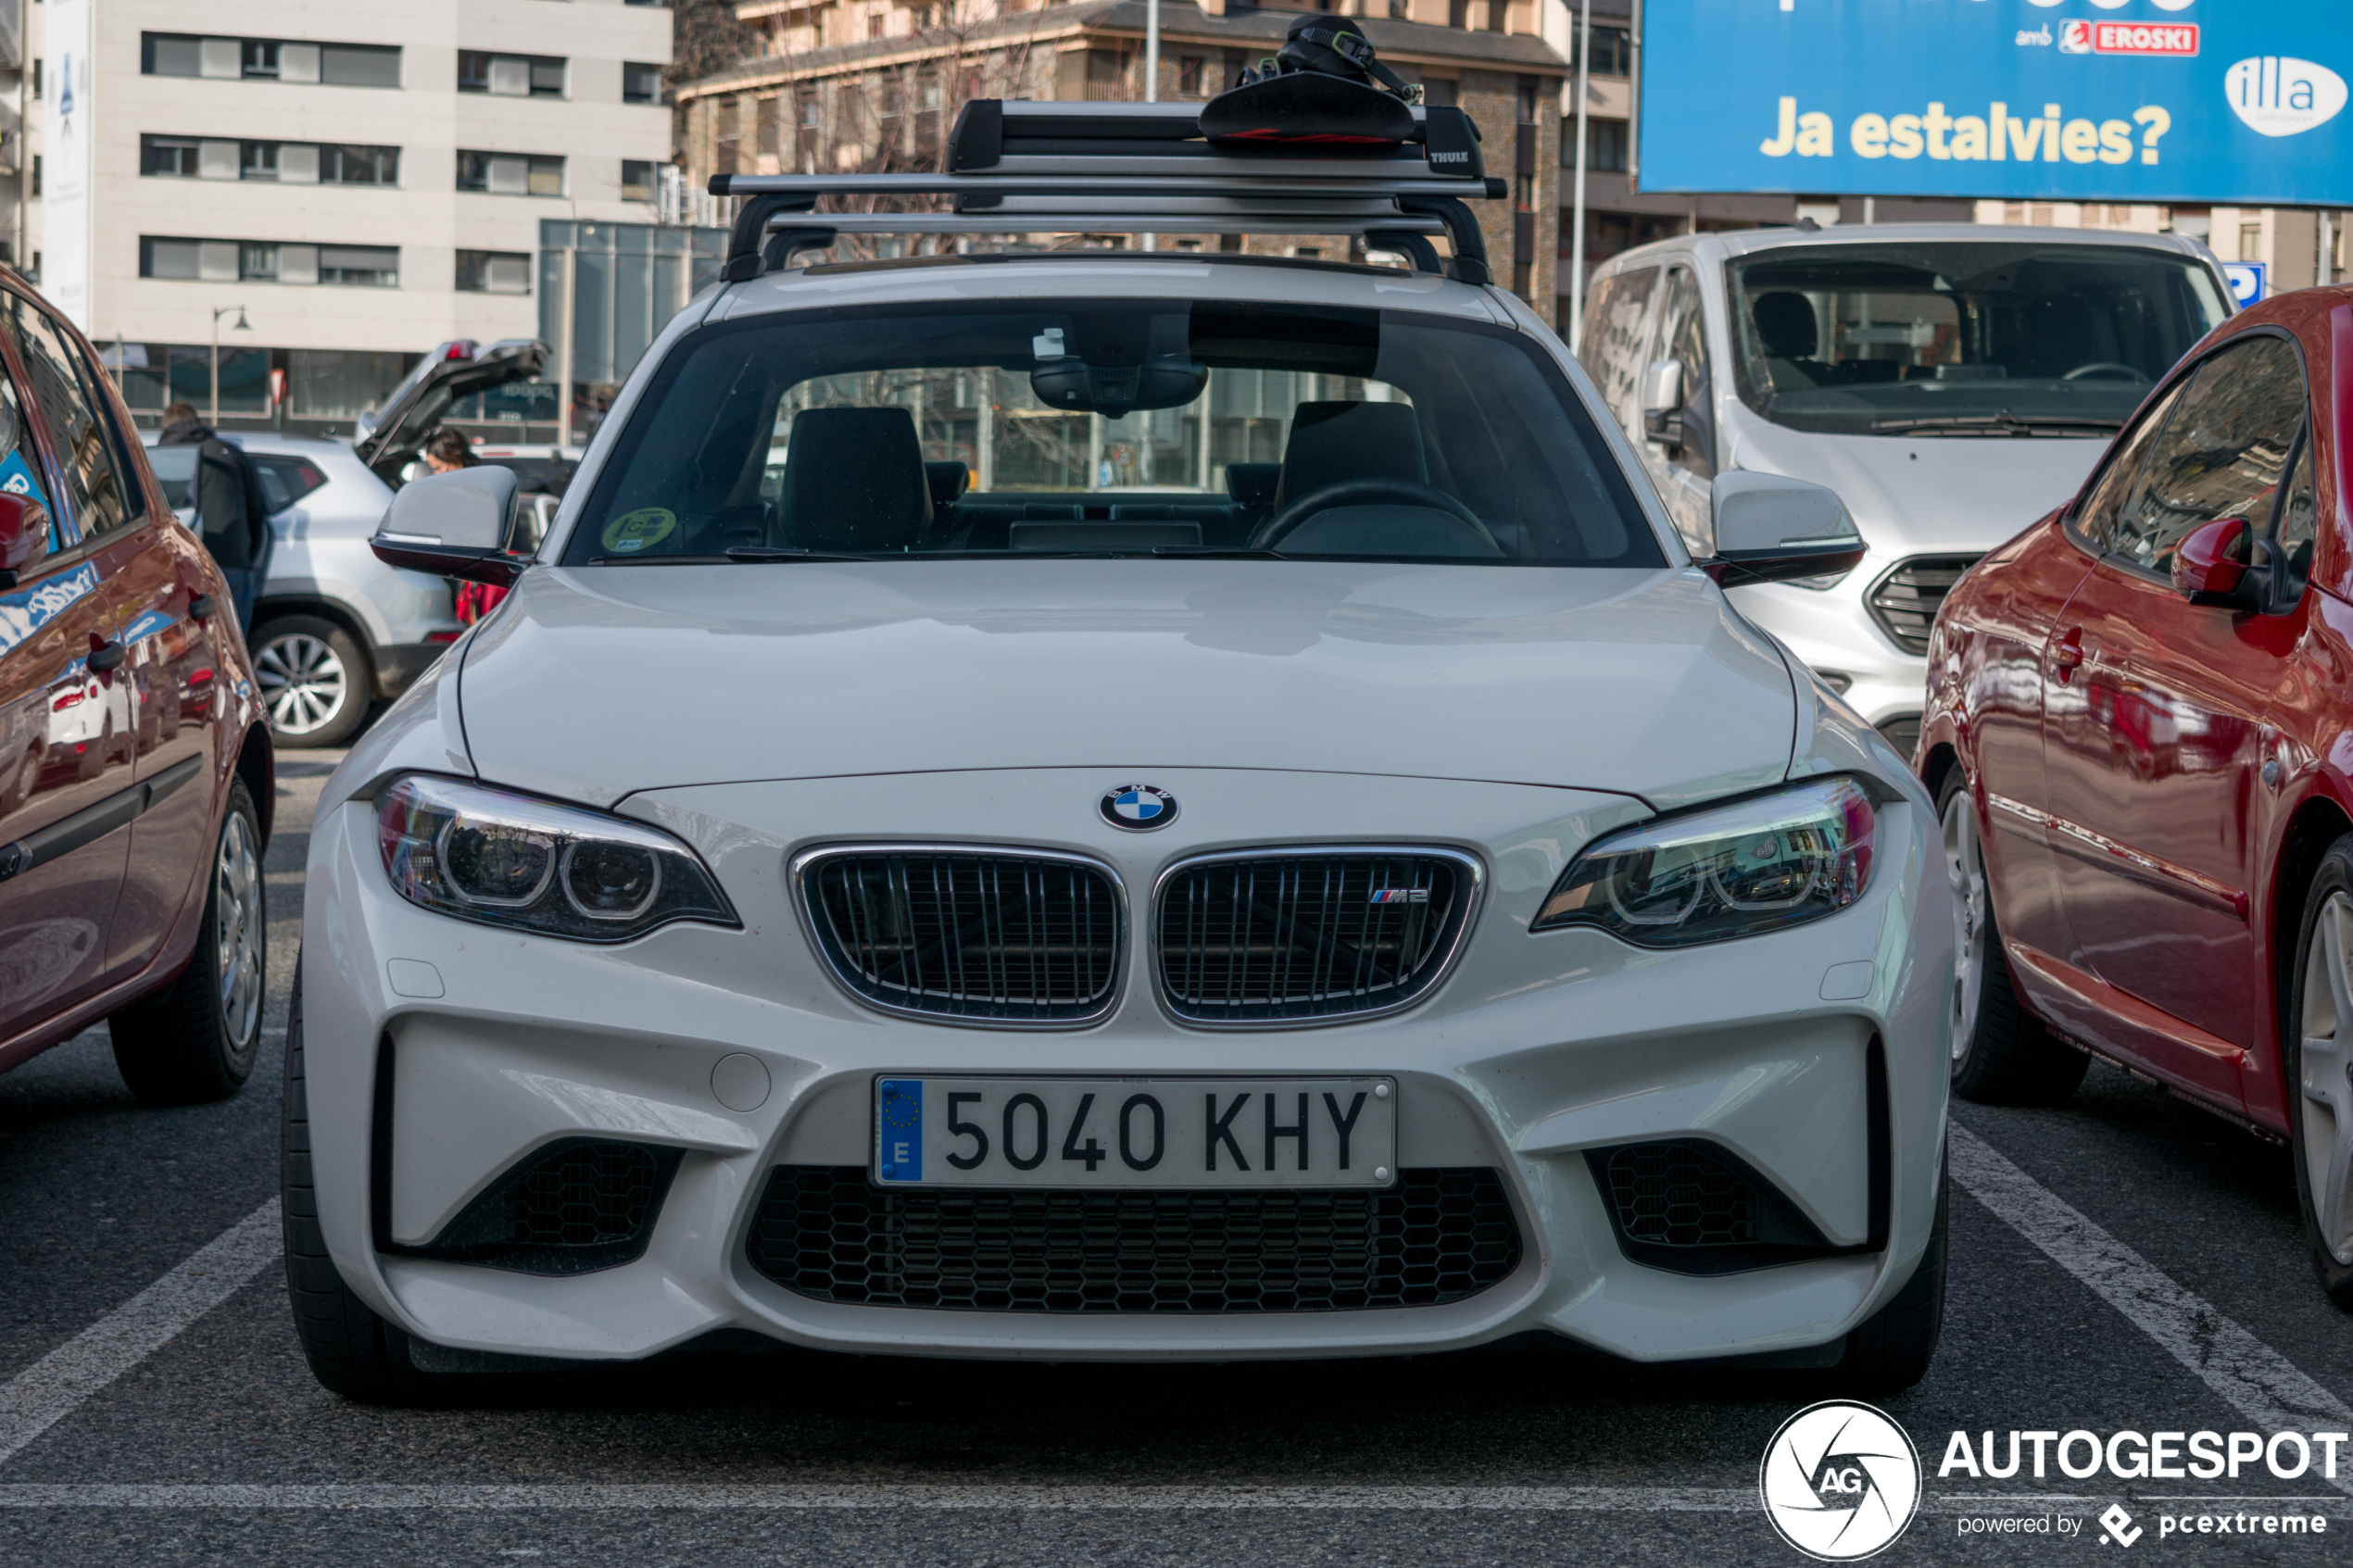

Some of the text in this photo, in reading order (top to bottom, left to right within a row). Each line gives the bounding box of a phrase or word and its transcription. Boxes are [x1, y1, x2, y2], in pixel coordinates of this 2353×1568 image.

[2015, 22, 2053, 46] amb
[2099, 26, 2192, 50] EROSKI
[2241, 56, 2314, 110] illa
[1759, 96, 2171, 166] Ja estalvies?
[1429, 151, 1469, 164] THULE
[1106, 784, 1172, 799] BMW
[1380, 889, 1428, 904] M2
[894, 1091, 1368, 1173] E 5040 KHY
